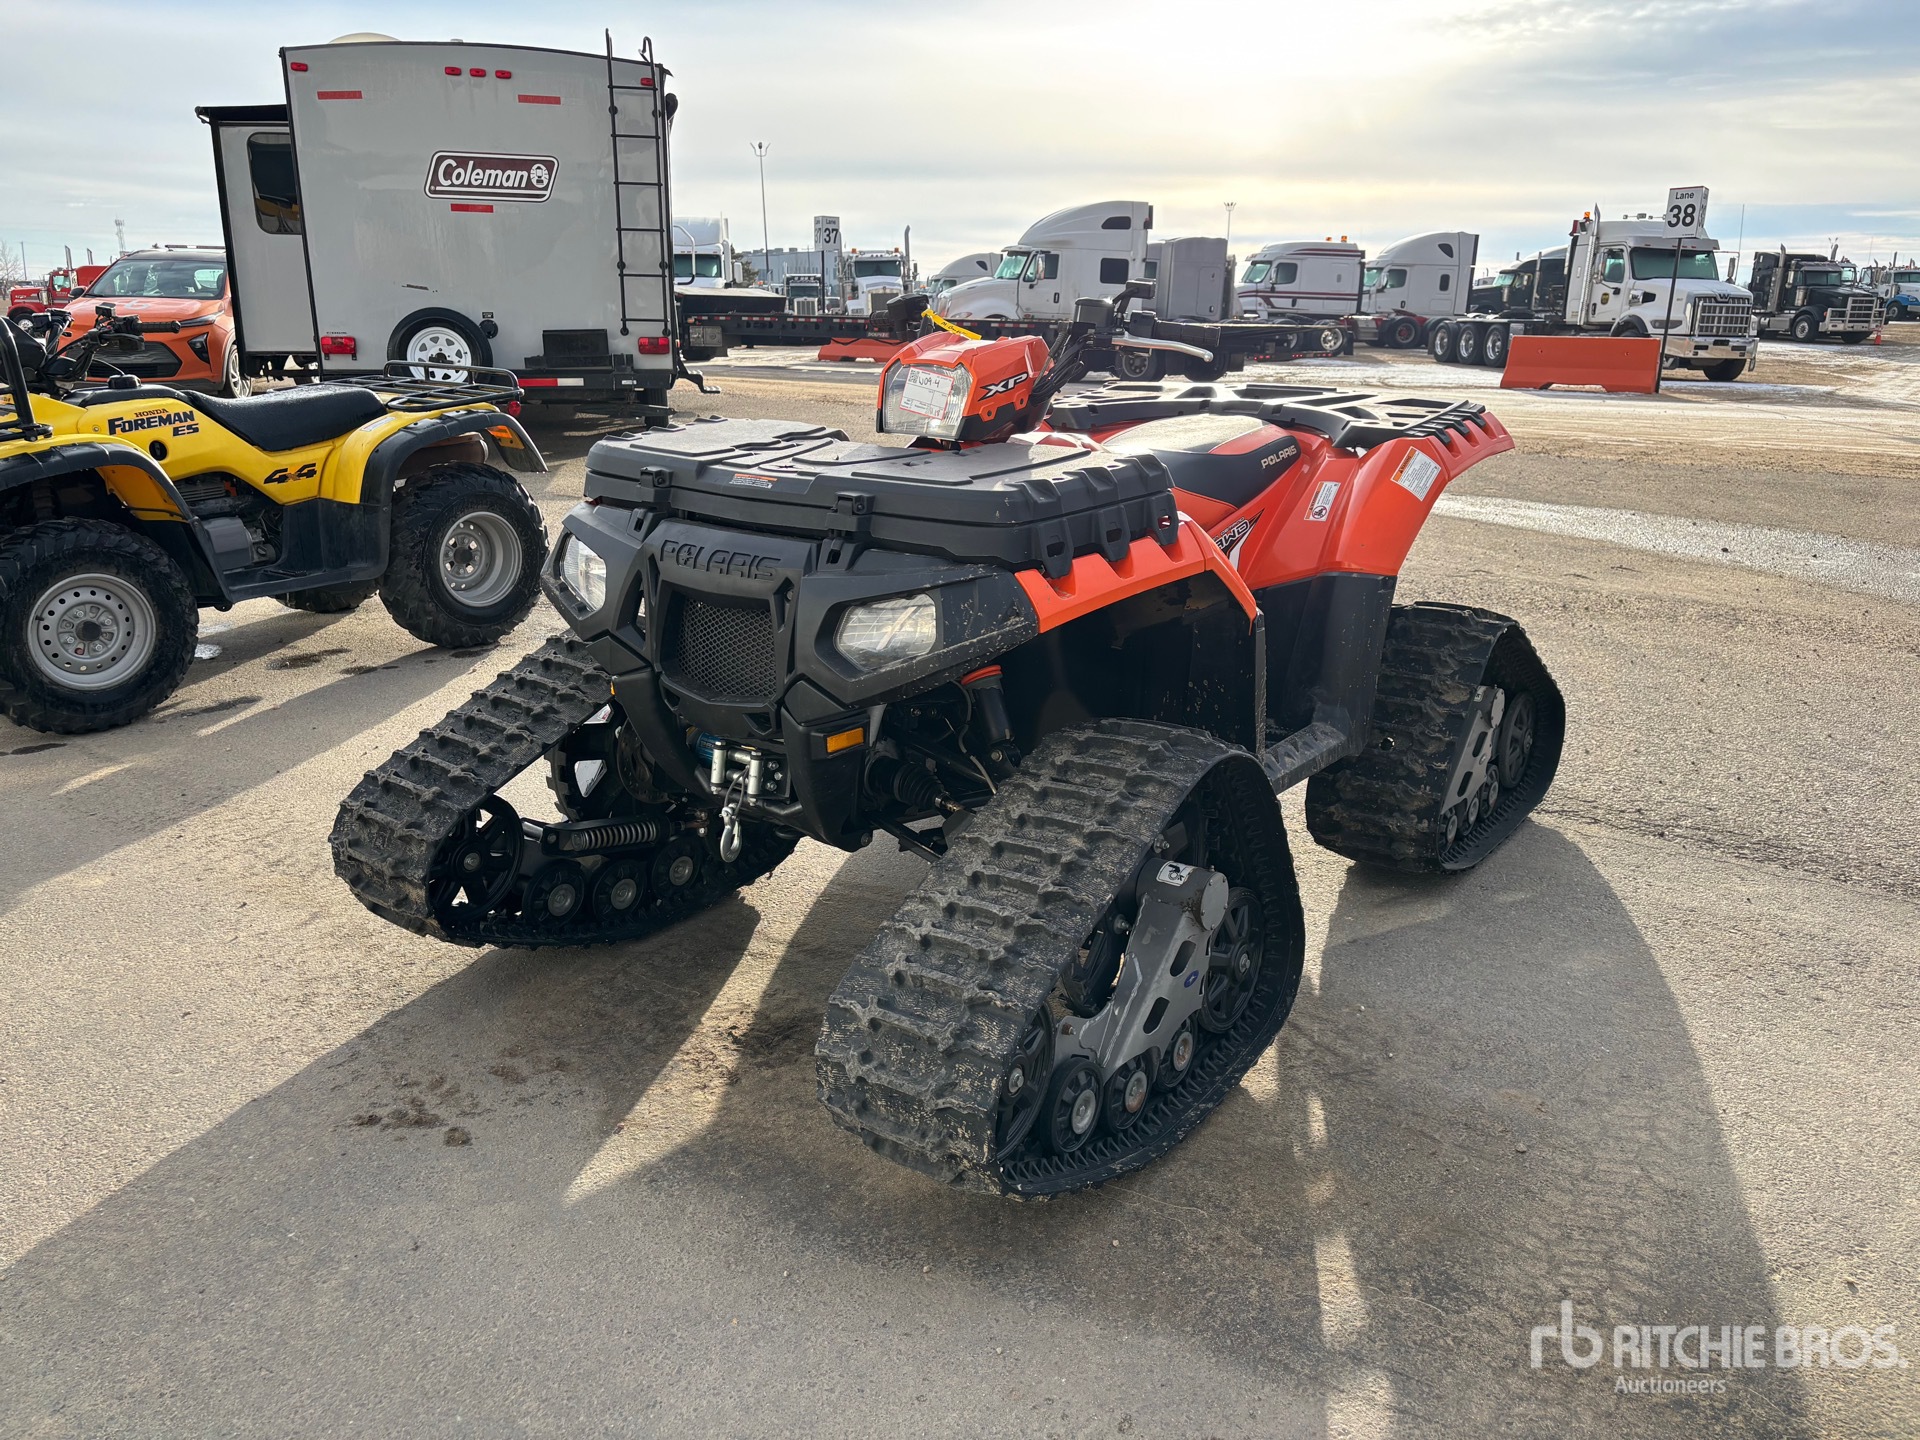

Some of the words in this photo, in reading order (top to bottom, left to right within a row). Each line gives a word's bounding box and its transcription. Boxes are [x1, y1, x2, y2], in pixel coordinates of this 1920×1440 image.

[438, 158, 529, 187] Coleman
[1675, 192, 1695, 200] Lane
[1667, 203, 1697, 228] 38
[823, 227, 839, 244] 37
[979, 372, 1029, 401] XP
[108, 410, 196, 436] FOREMAN
[134, 408, 169, 418] HONDA
[172, 422, 200, 437] ES
[1261, 444, 1298, 470] POLARIS
[659, 539, 782, 580] POLARIS
